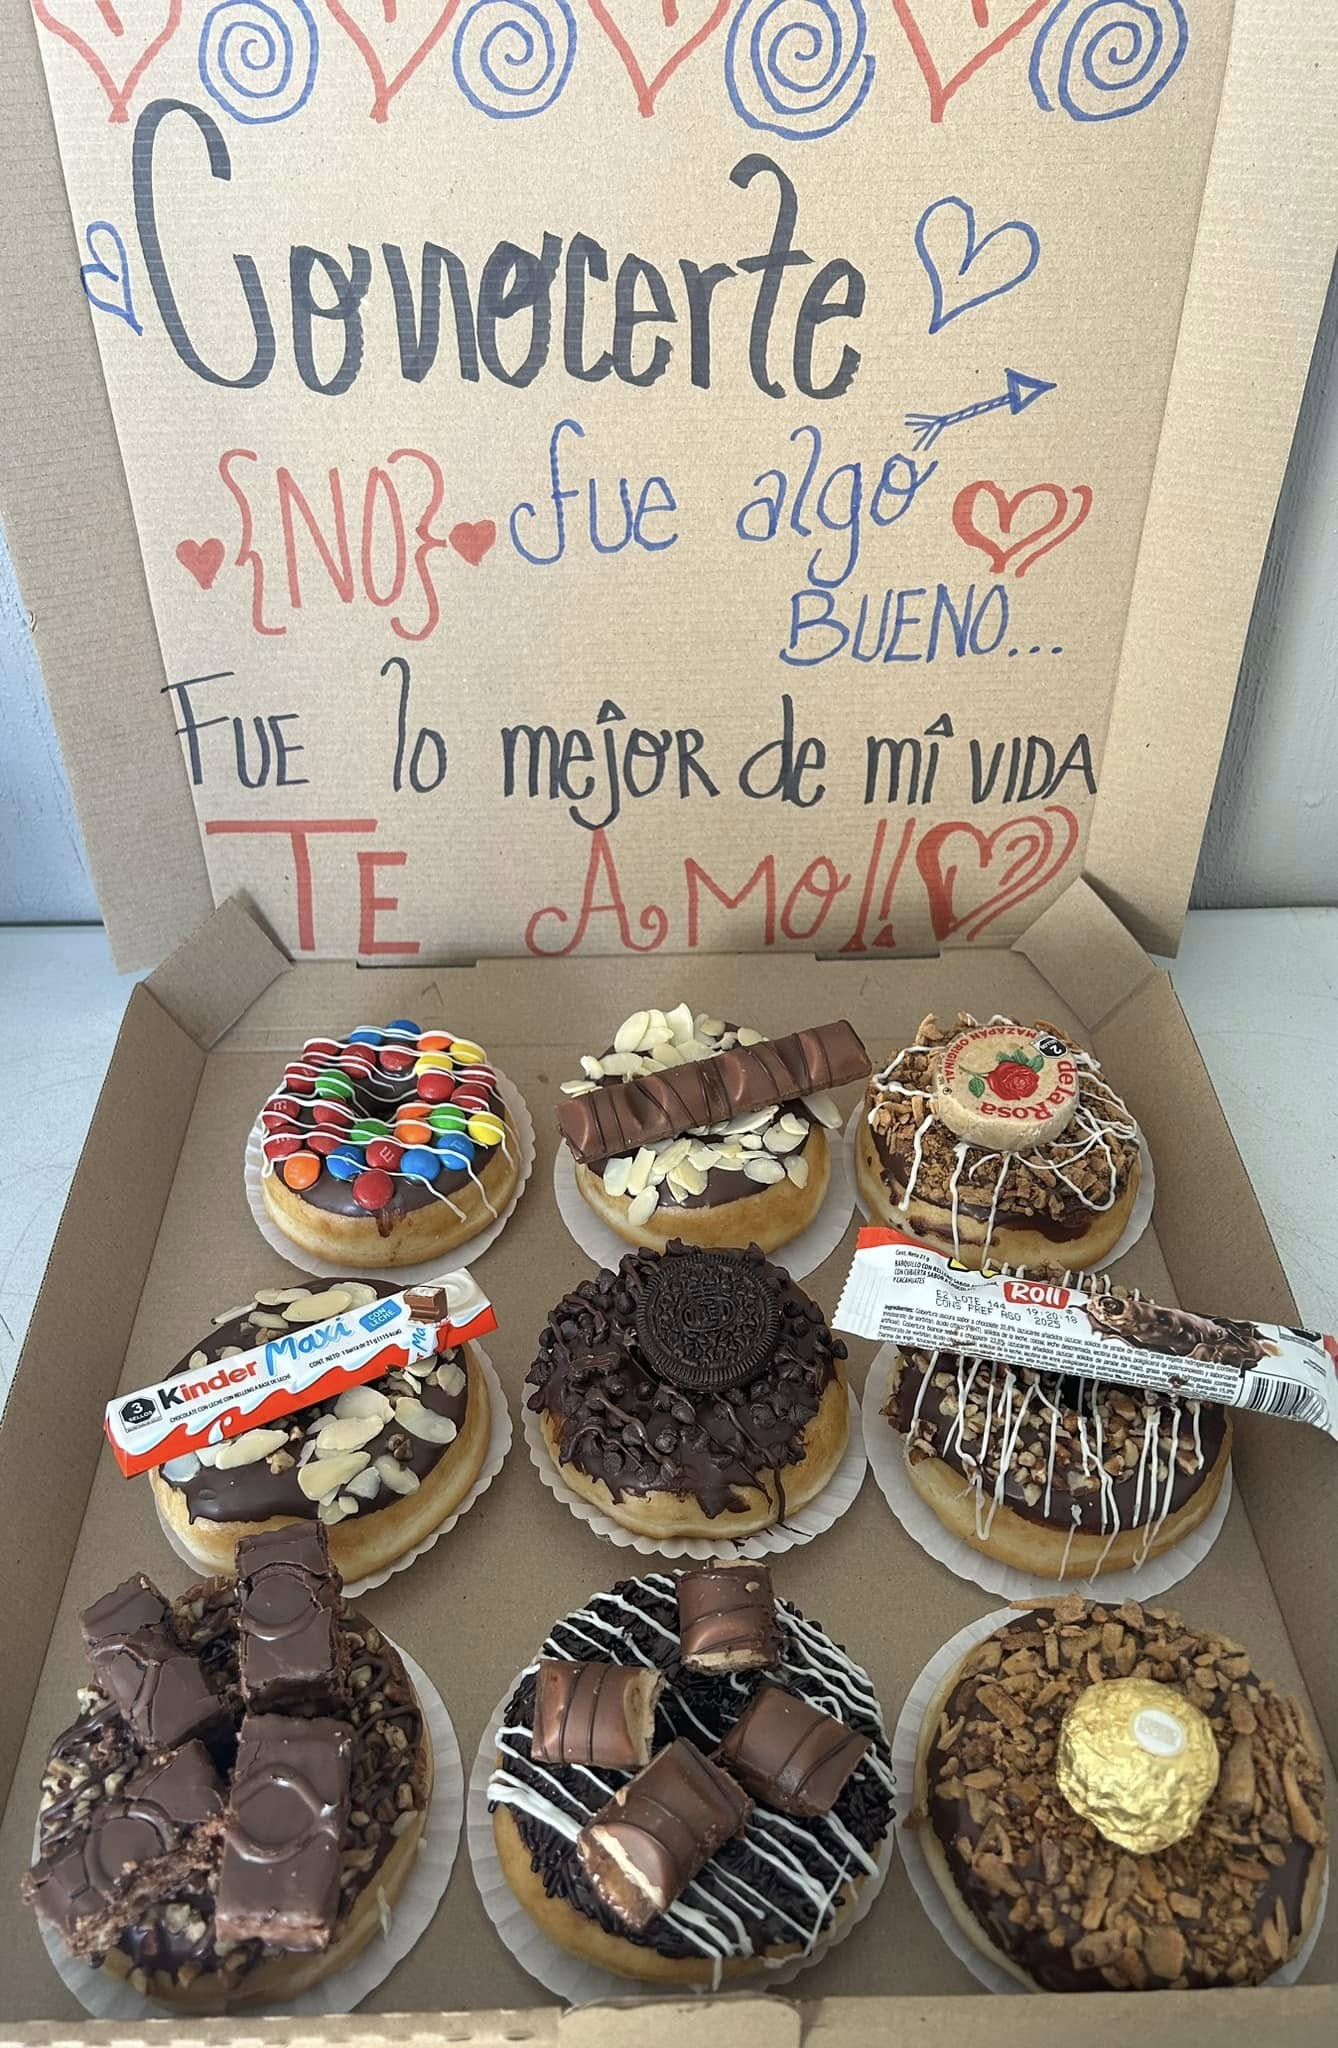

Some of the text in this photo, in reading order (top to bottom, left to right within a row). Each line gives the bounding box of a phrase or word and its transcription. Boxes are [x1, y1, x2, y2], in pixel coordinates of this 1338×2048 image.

[132, 98, 867, 399] Conocerte
[509, 420, 677, 565] fue
[737, 426, 937, 588] algo
[161, 672, 309, 788] FUE
[381, 657, 448, 793] lo
[739, 694, 826, 808] de
[969, 733, 1098, 804] VIDA
[206, 819, 421, 955] TE
[944, 1038, 969, 1083] ORIGINAL
[980, 1102, 1054, 1120] Rosa
[368, 1307, 388, 1320] CON
[369, 1309, 394, 1327] LECHE
[935, 1298, 1061, 1329] CONS PREF AGO 2025
[954, 1295, 981, 1306] LOTE
[988, 1300, 1007, 1310] 144
[265, 1316, 353, 1375] Maxi
[131, 1402, 143, 1414] 3
[170, 1408, 198, 1423] CHOCOLATE
[198, 1405, 209, 1413] CON
[208, 1398, 224, 1410] LECHE
[223, 1395, 234, 1403] CON
[234, 1387, 255, 1401] RELLENO
[258, 1381, 271, 1391] BASE
